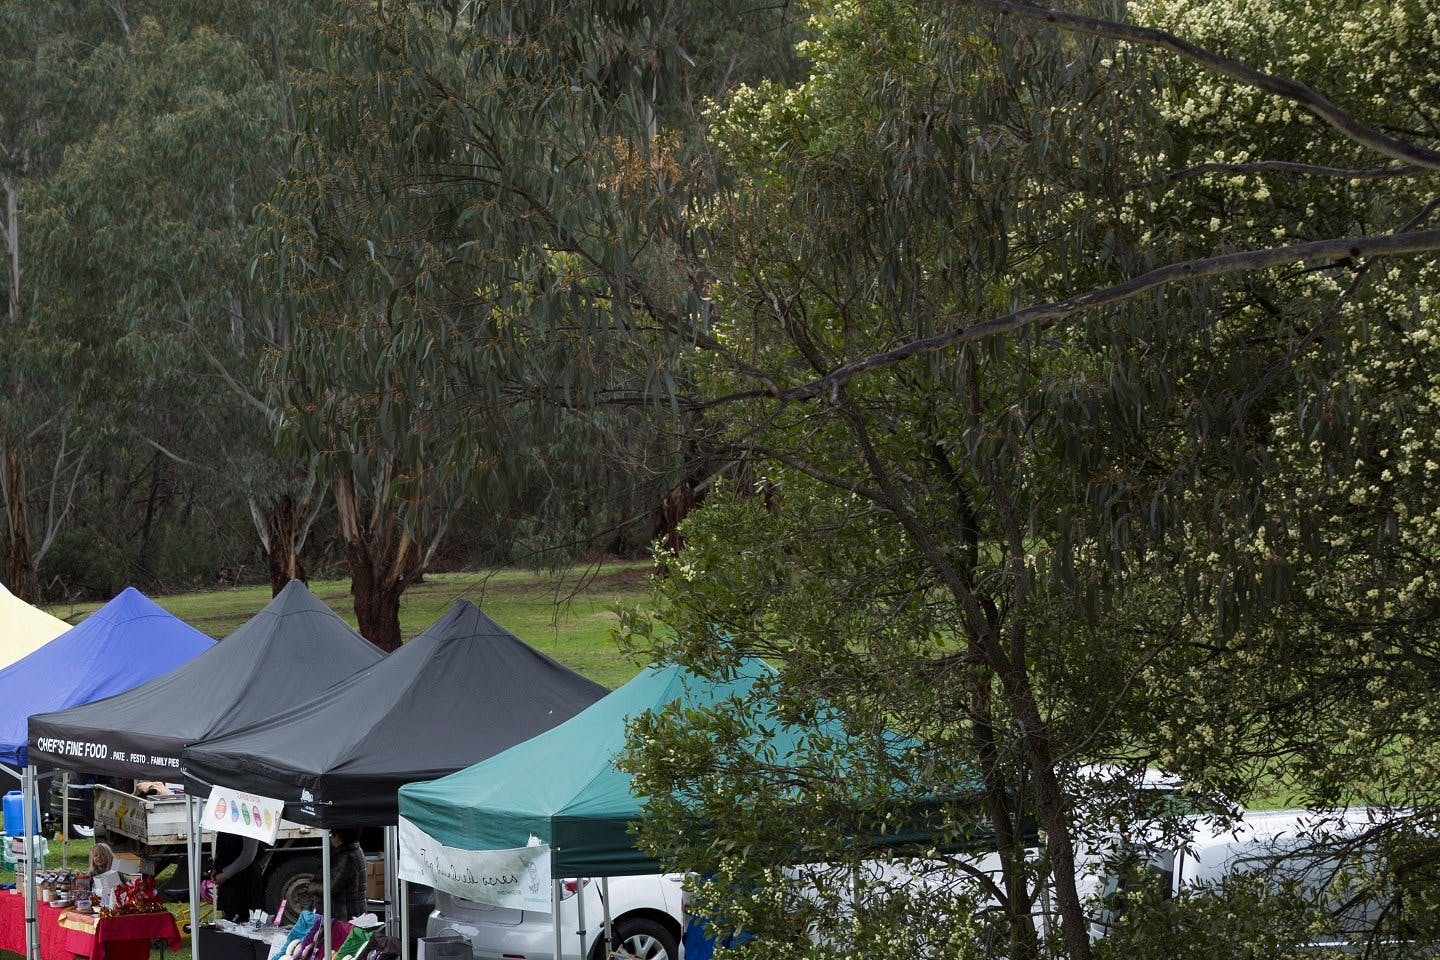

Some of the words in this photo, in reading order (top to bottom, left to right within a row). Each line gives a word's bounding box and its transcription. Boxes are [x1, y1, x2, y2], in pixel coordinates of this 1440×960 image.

[38, 737, 63, 754] CHEF'S
[65, 740, 83, 756] FINE
[84, 743, 108, 759] FOOD
[113, 752, 125, 761] PATE
[130, 753, 145, 764] PESTO
[151, 756, 167, 767] FAMILY
[168, 758, 180, 768] PIES
